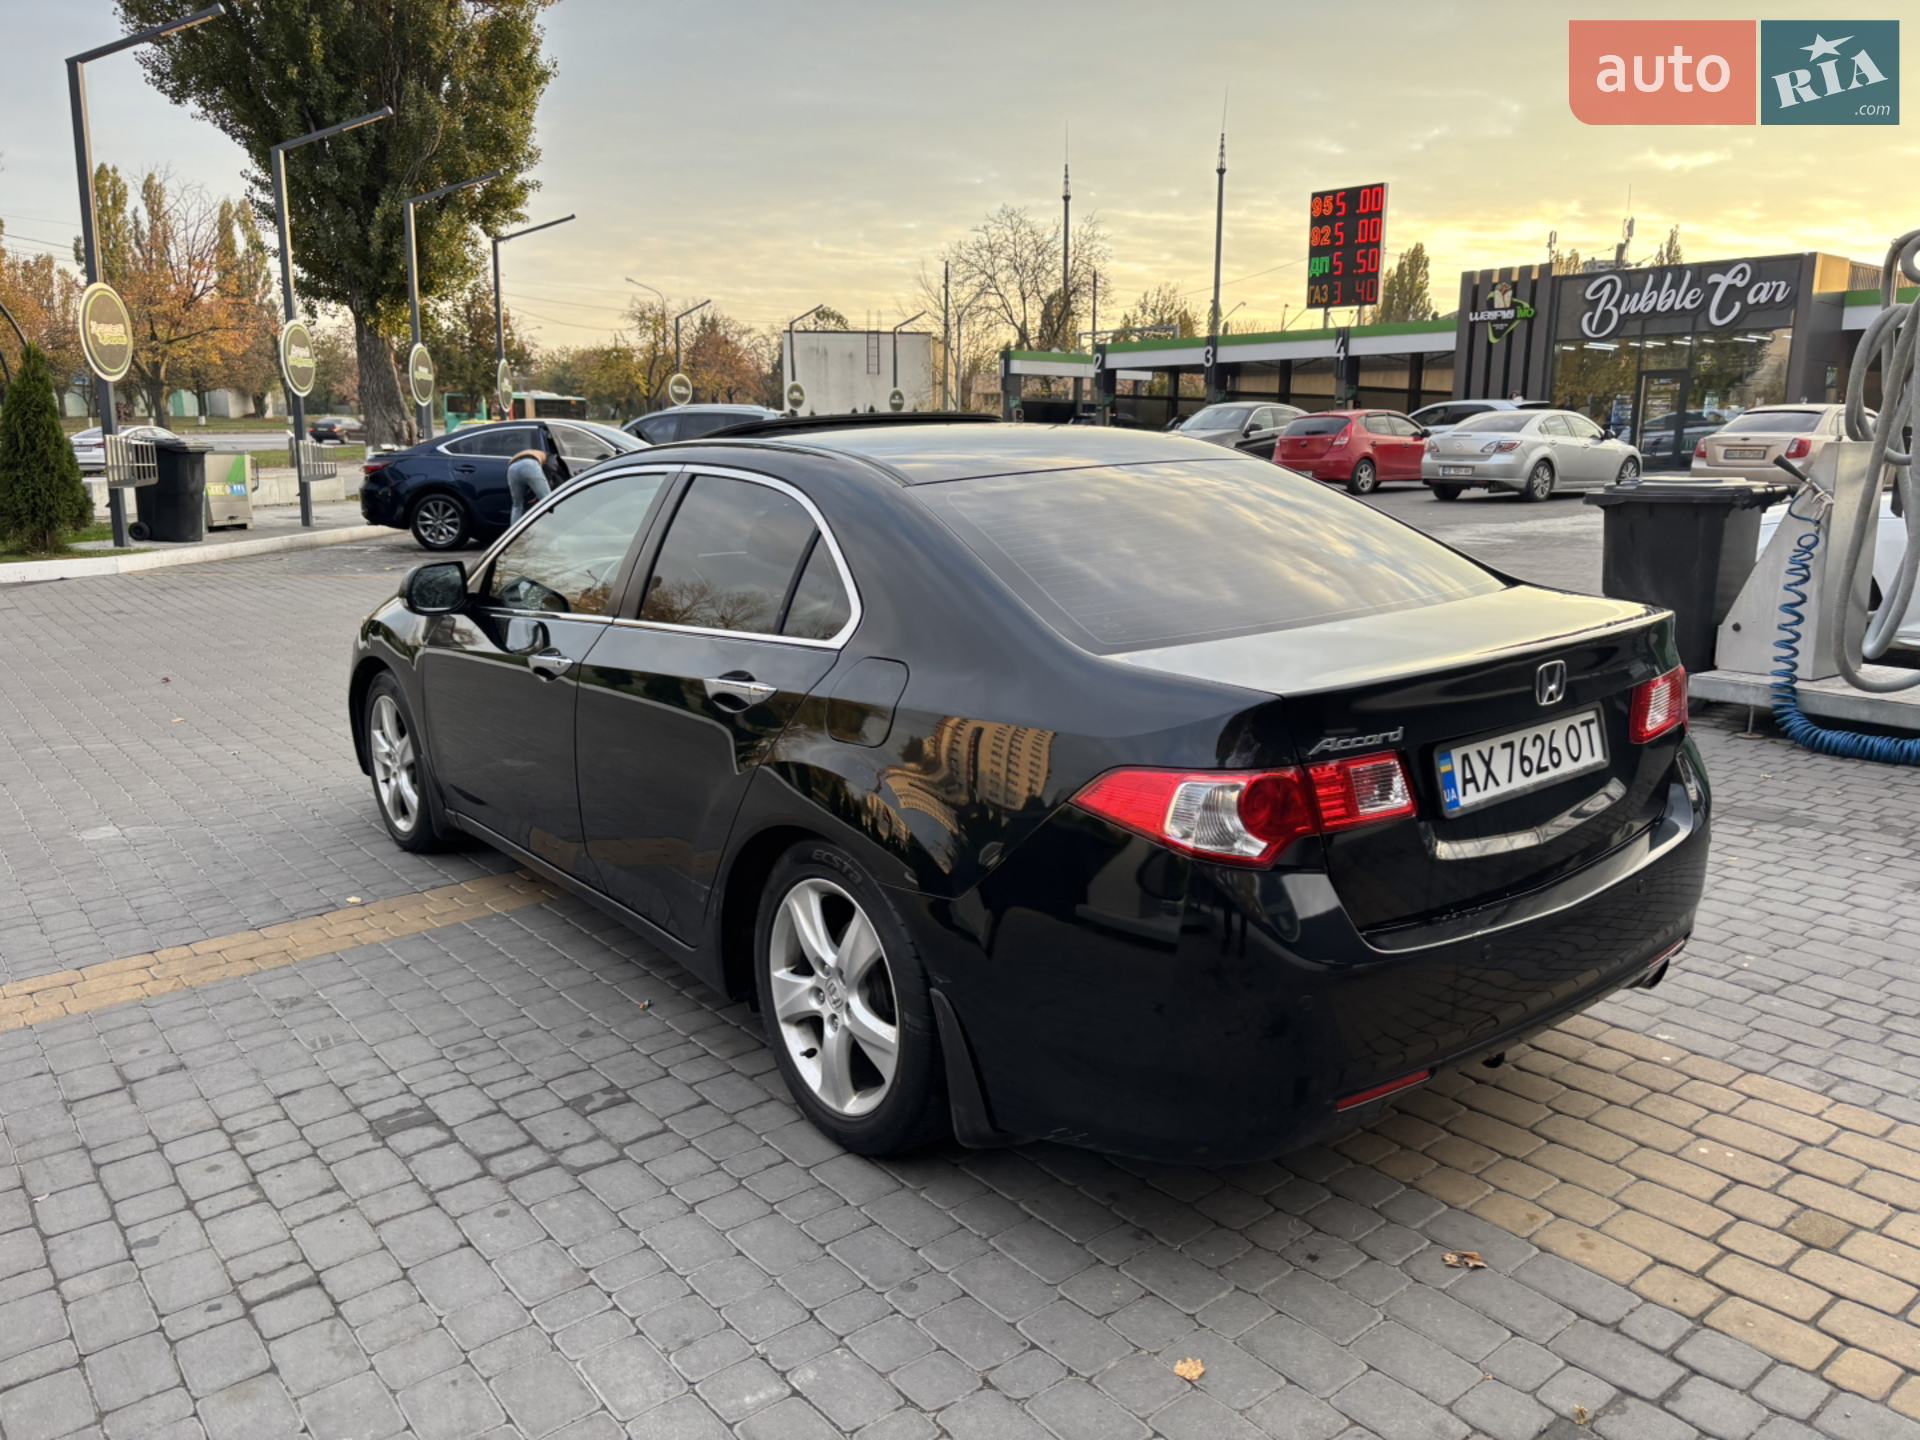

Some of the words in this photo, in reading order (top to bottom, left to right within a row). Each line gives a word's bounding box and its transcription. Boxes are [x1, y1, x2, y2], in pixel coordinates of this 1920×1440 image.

[1311, 195, 1334, 217] 95
[1311, 225, 1332, 247] 92
[1309, 256, 1330, 278] ДП
[1309, 284, 1329, 304] ГАЗ
[1581, 270, 1704, 338] Bubble
[1707, 262, 1791, 326] Car
[1203, 345, 1213, 367] 3
[1333, 336, 1346, 361] 4
[1093, 353, 1102, 373] 2
[1308, 726, 1404, 755] Accord
[1444, 788, 1458, 802] UA
